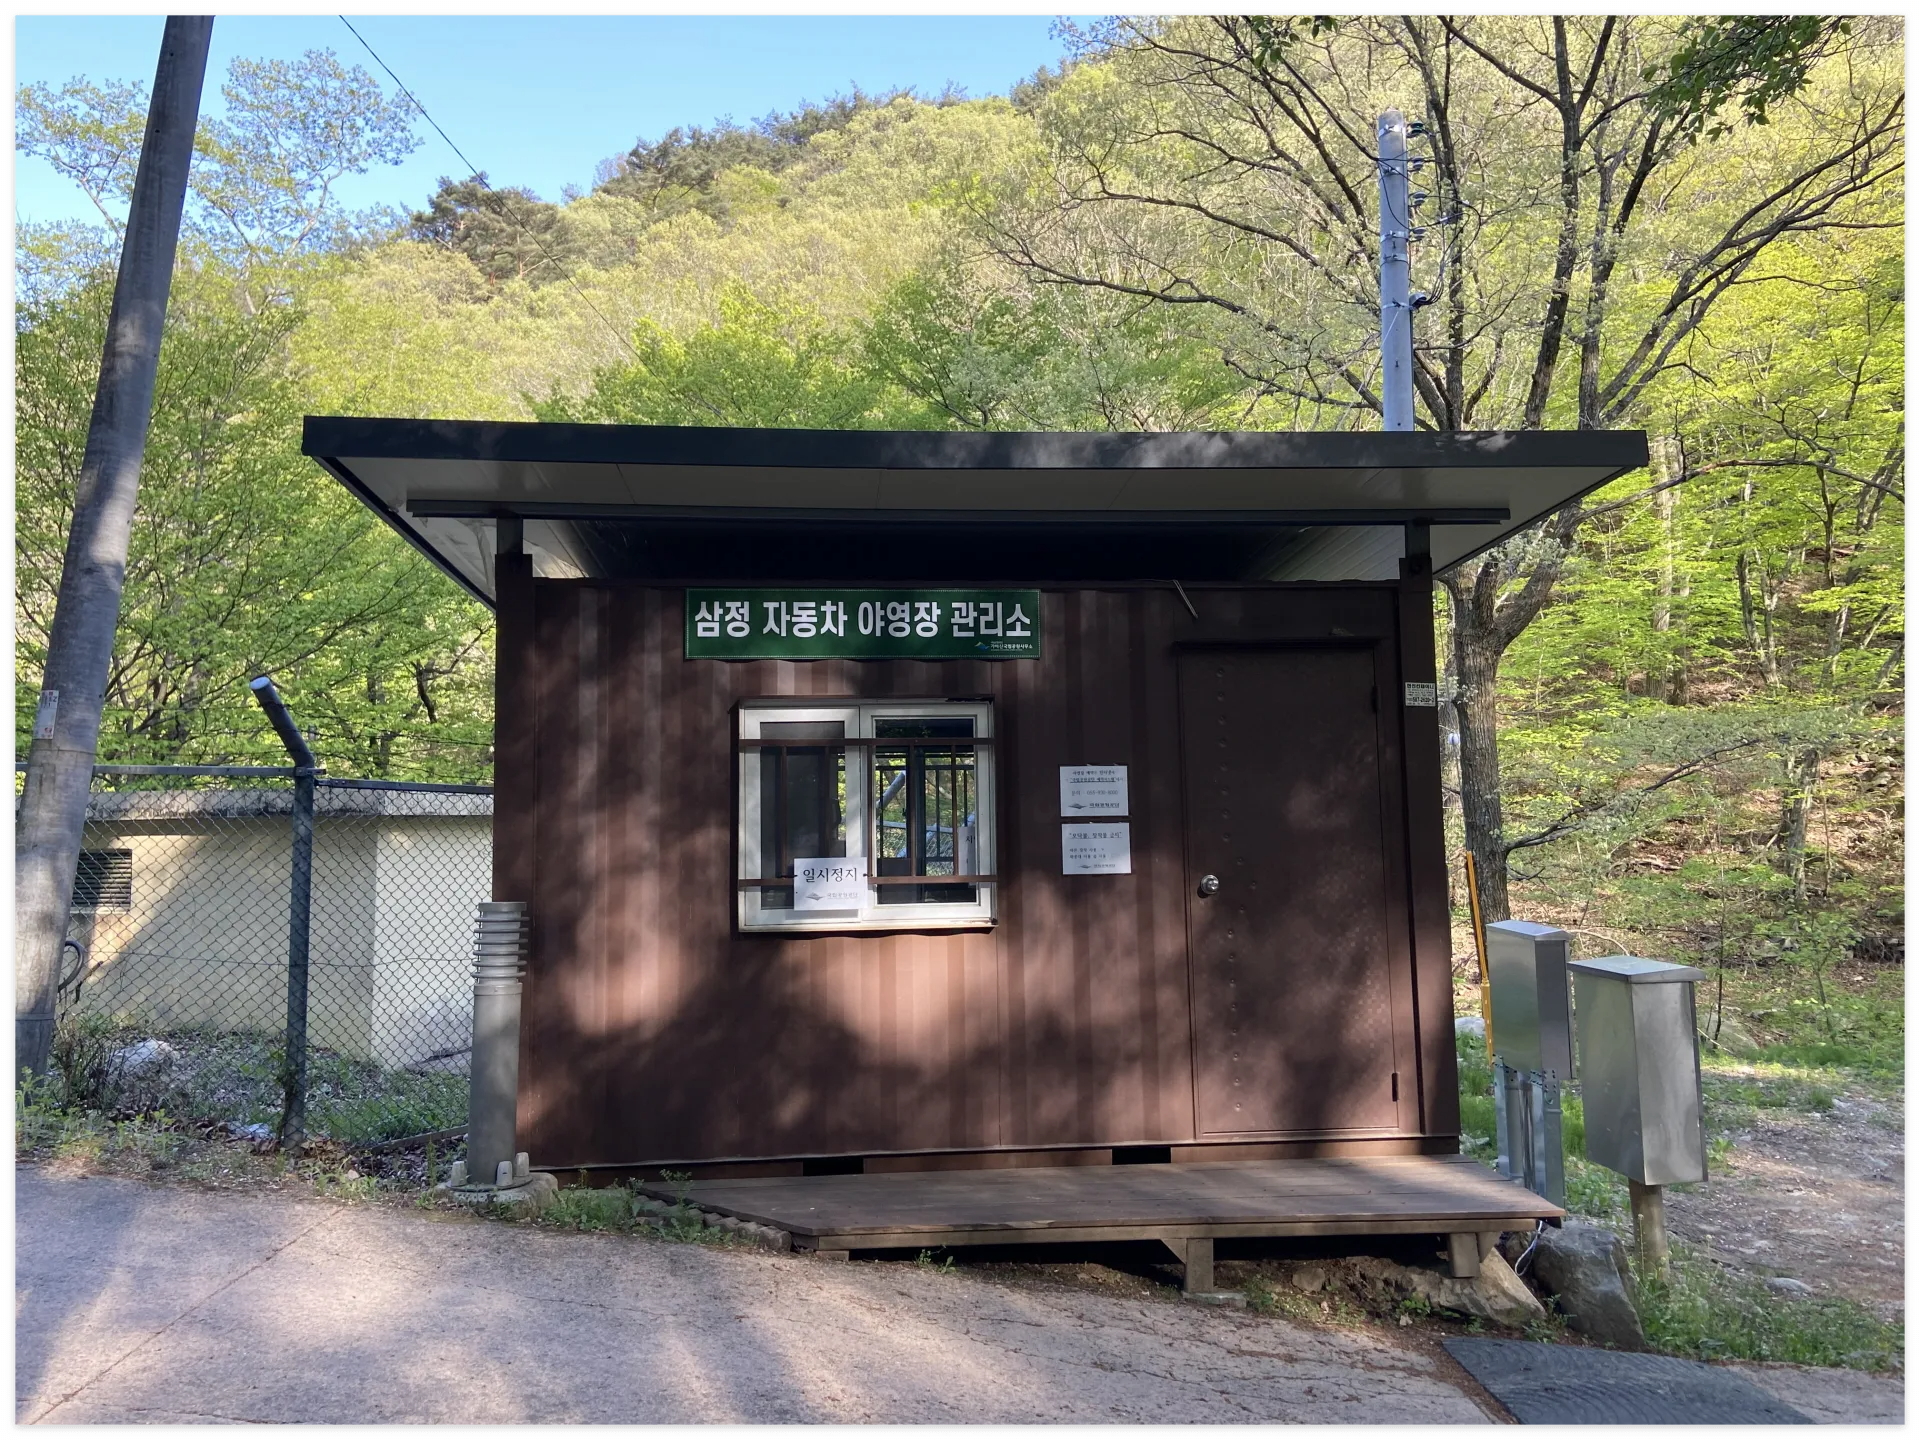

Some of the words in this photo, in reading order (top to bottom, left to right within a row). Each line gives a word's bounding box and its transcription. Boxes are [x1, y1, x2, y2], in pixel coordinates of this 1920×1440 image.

[694, 601, 750, 637] 삼정
[762, 600, 848, 637] 자동차
[858, 601, 942, 637] 야영장
[951, 602, 1031, 637] 관리소
[803, 868, 857, 882] 일시정지
